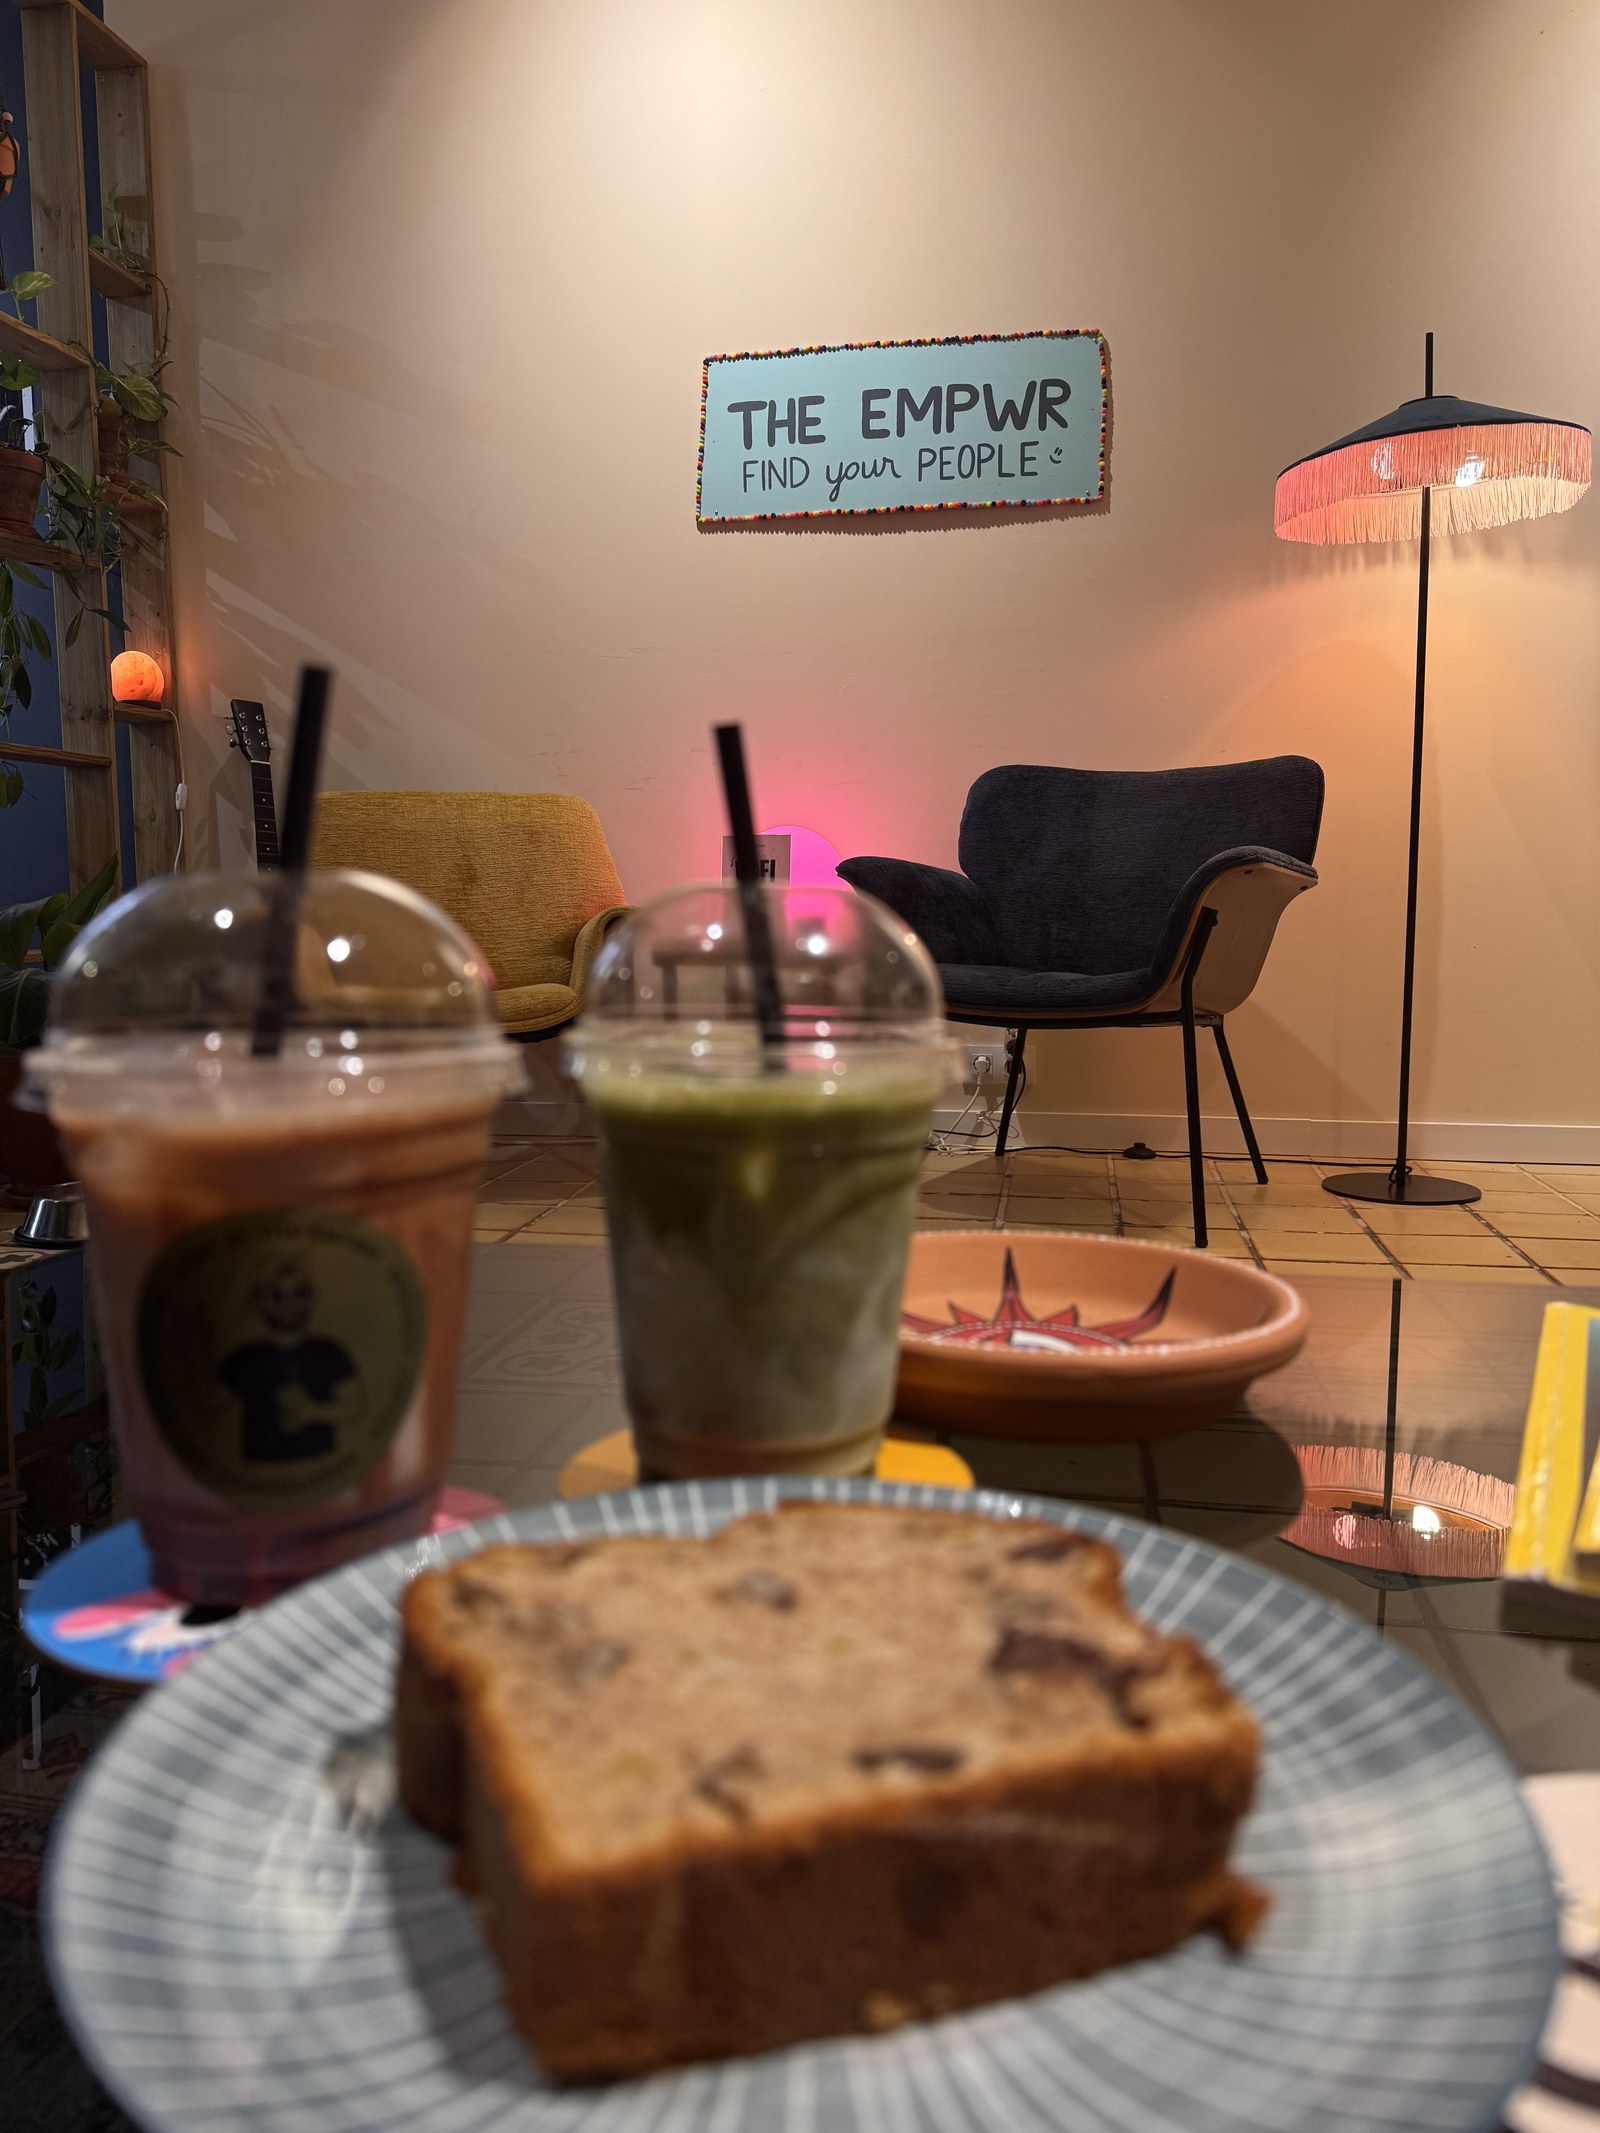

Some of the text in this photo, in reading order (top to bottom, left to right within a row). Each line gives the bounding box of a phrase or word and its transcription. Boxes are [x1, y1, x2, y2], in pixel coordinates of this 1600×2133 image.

[727, 378, 1072, 450] THE EMPWR
[743, 441, 1040, 502] FIND your PEOPLE
